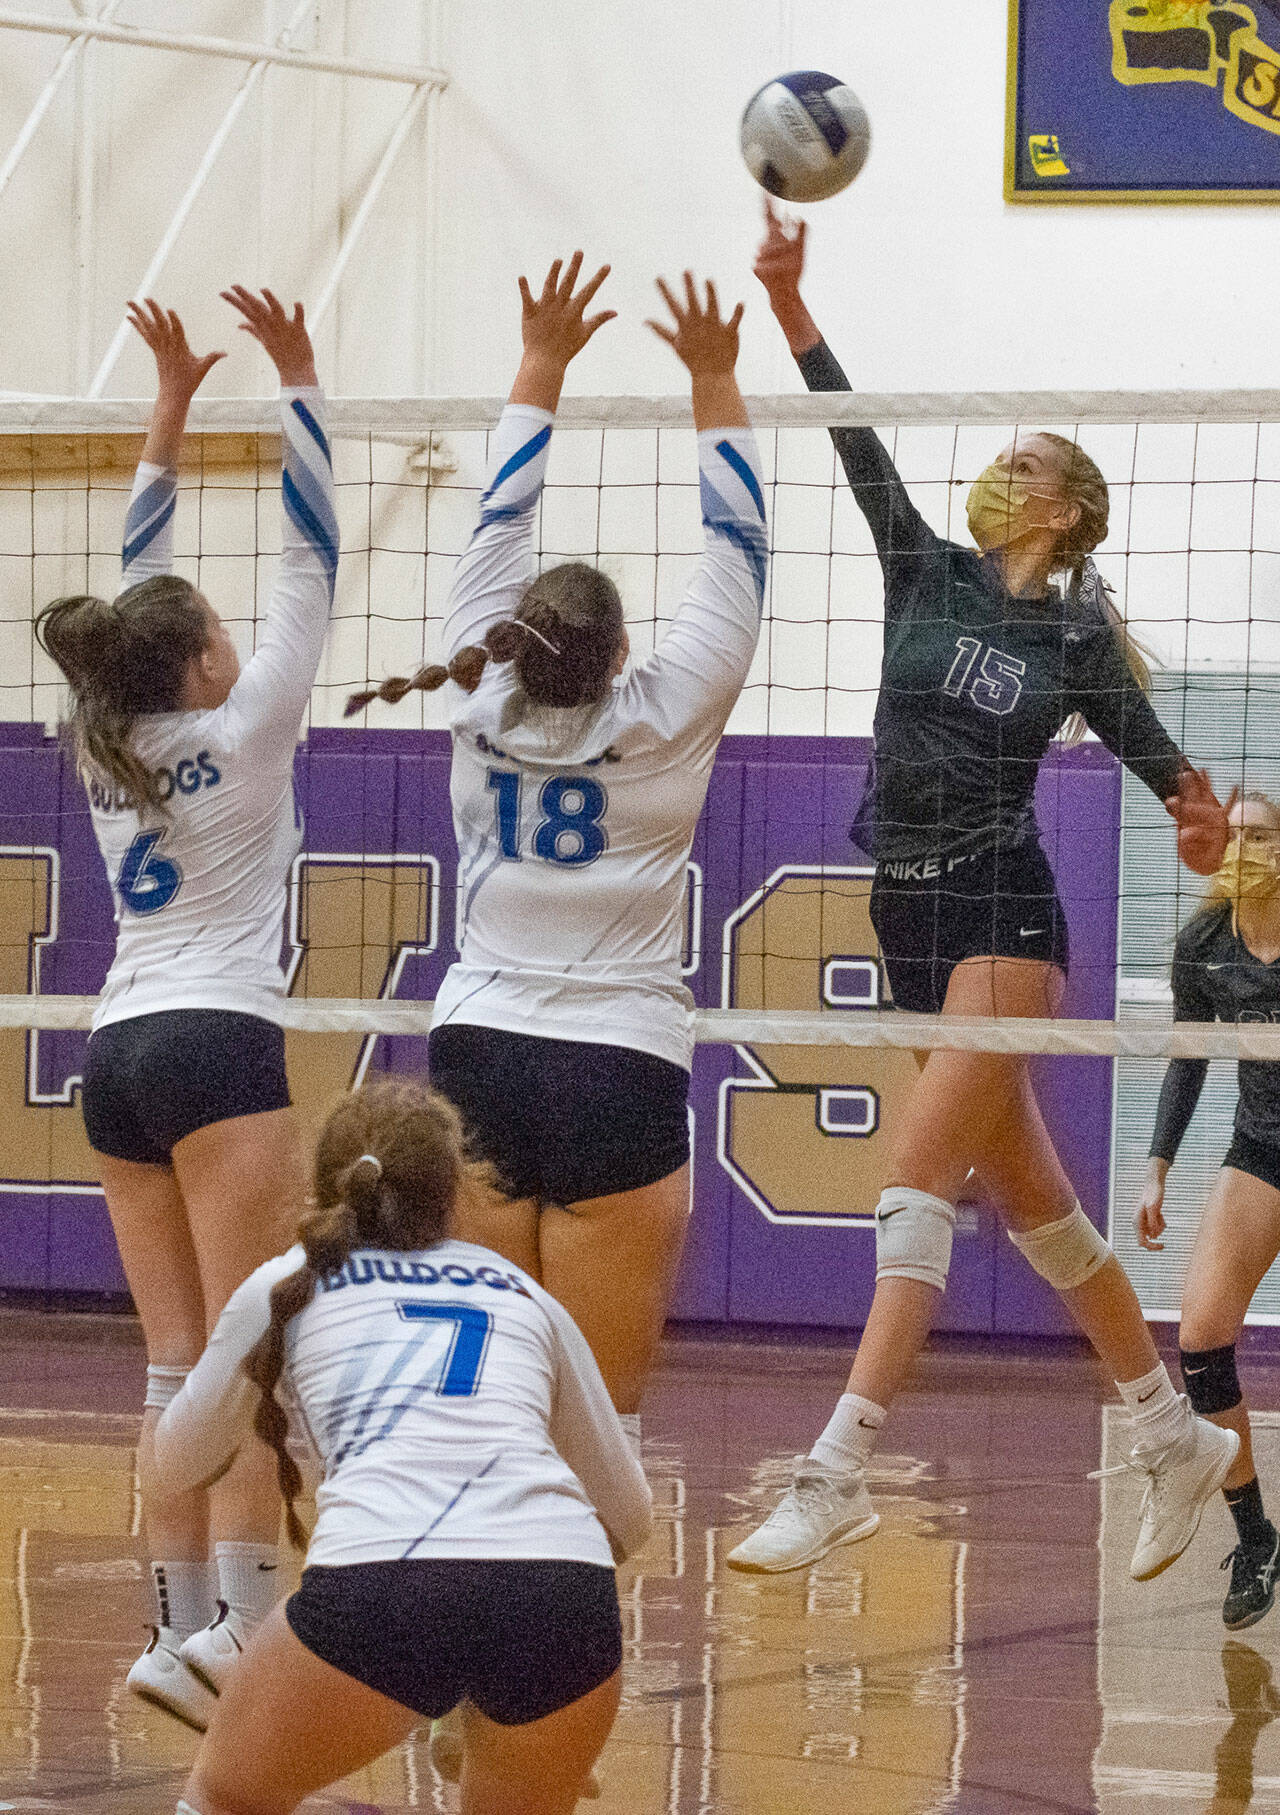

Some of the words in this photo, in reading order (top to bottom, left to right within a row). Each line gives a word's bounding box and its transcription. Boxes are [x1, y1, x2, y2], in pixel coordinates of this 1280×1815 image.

[943, 636, 1027, 716] 15
[89, 750, 222, 813] BULOGS
[485, 766, 610, 871] 18
[114, 825, 184, 918] 6
[884, 858, 941, 880] NIKE
[394, 1301, 495, 1398] 7
